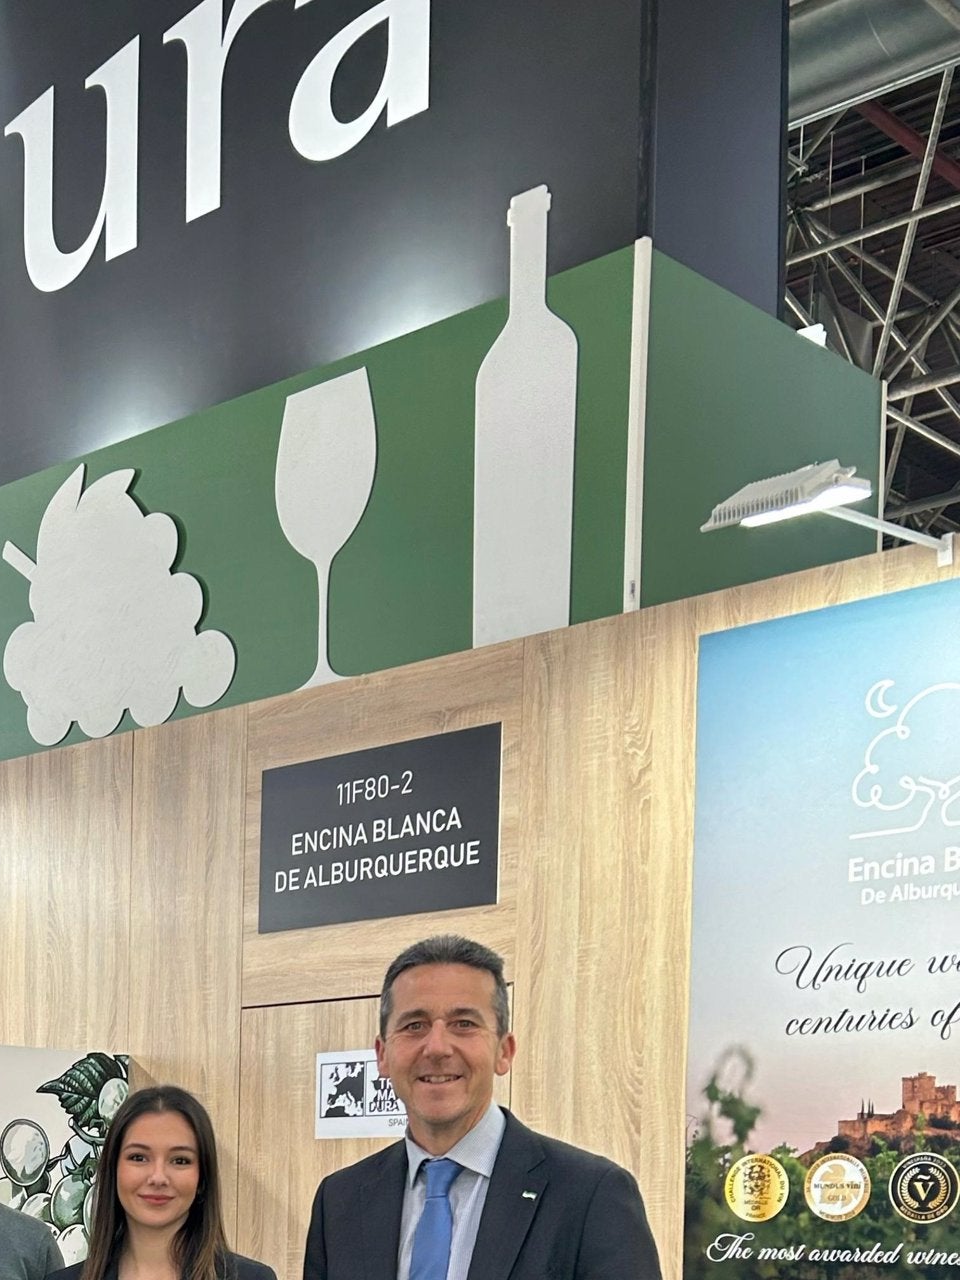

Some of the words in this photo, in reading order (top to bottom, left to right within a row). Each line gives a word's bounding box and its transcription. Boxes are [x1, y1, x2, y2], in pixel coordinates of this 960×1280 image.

[336, 770, 414, 806] 11F80-2
[291, 822, 368, 856] ENCINA
[372, 806, 463, 843] BLANCA
[274, 868, 300, 893] DE
[303, 840, 481, 889] ALBURQUERQUE
[848, 852, 936, 882] Encina
[861, 887, 887, 905] De
[775, 942, 916, 994] Unique
[785, 1006, 921, 1036] centuries
[706, 1232, 755, 1262] The
[757, 1244, 807, 1262] most
[808, 1242, 904, 1264] awarded
[906, 1248, 960, 1266] wine
